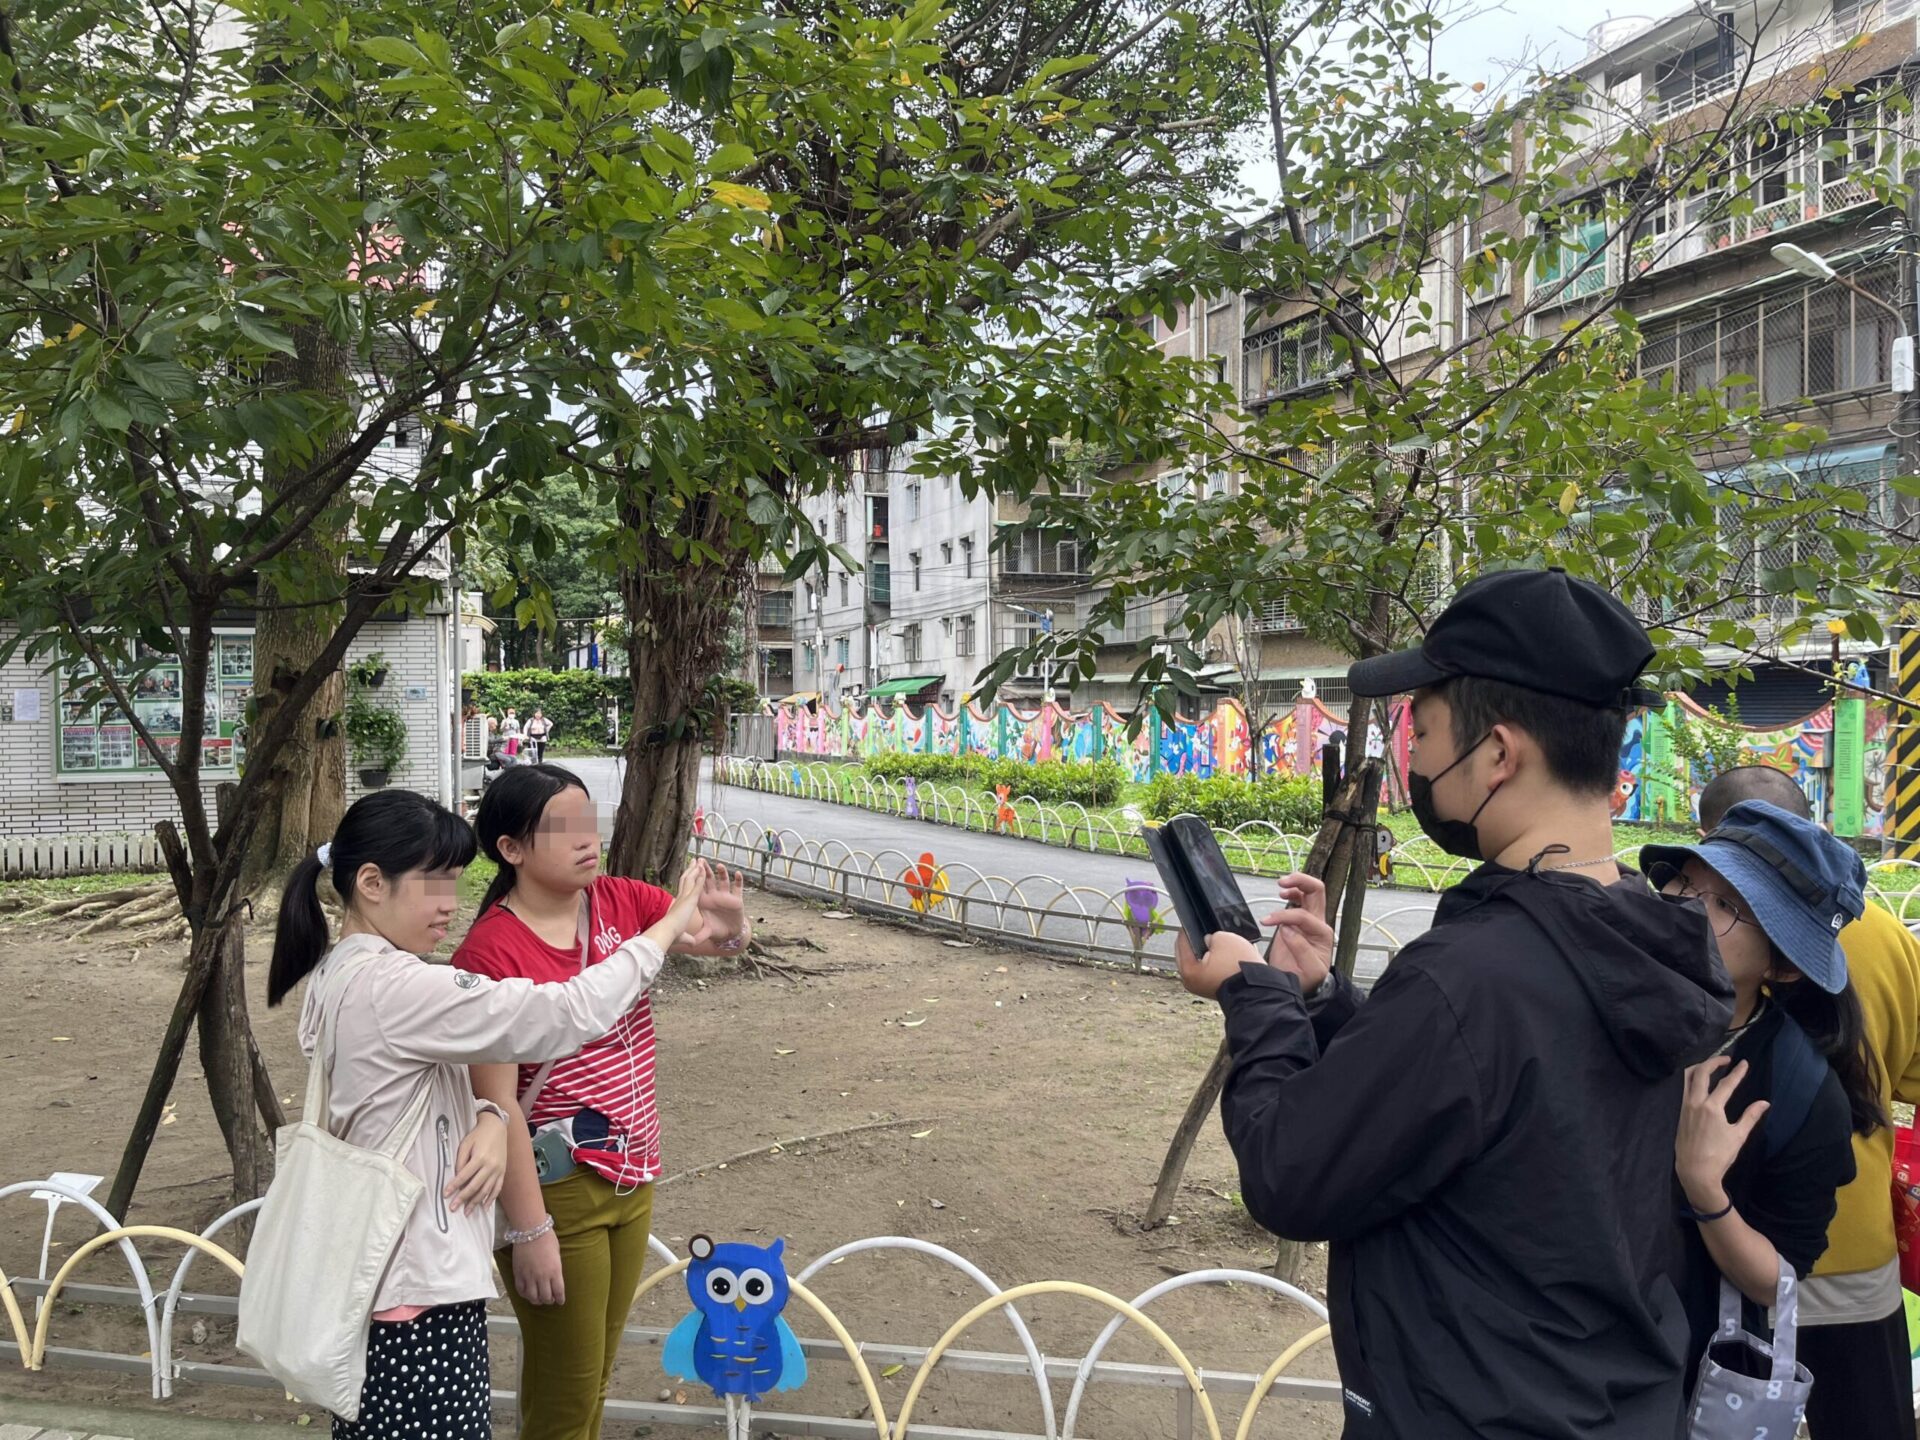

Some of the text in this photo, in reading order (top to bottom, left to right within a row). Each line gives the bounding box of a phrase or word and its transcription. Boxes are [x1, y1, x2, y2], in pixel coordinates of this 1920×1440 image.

[1781, 1276, 1794, 1295] 7
[1725, 1318, 1736, 1336] 5
[1766, 1380, 1783, 1399] 8
[1753, 1426, 1768, 1440] 2
